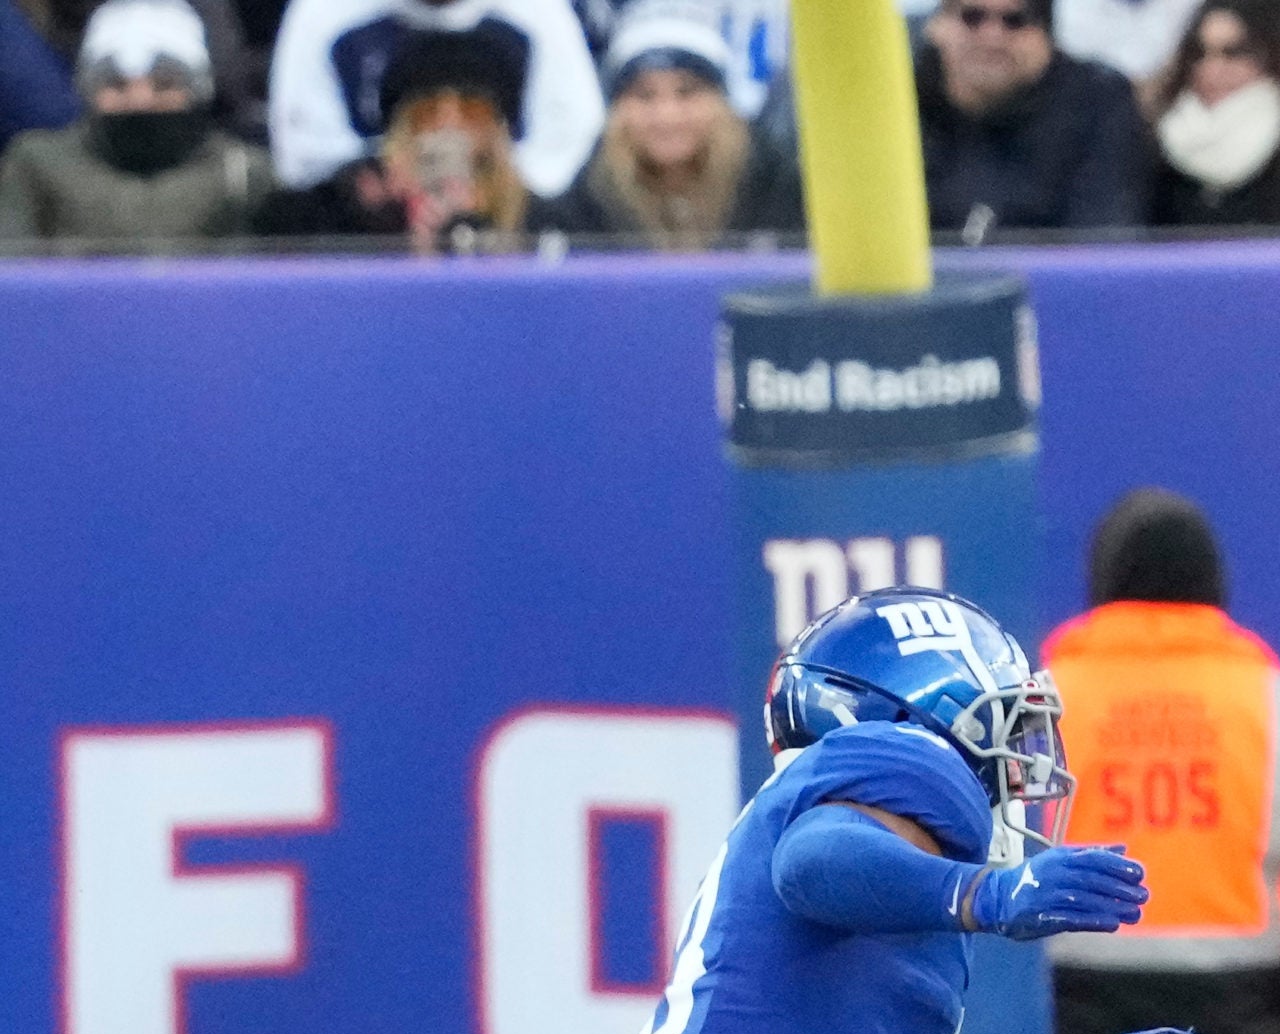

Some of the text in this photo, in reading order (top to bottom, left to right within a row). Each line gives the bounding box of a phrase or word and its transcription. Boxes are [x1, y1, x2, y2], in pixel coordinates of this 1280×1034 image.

[747, 354, 1001, 412] End Racism
[1099, 760, 1222, 832] SOS
